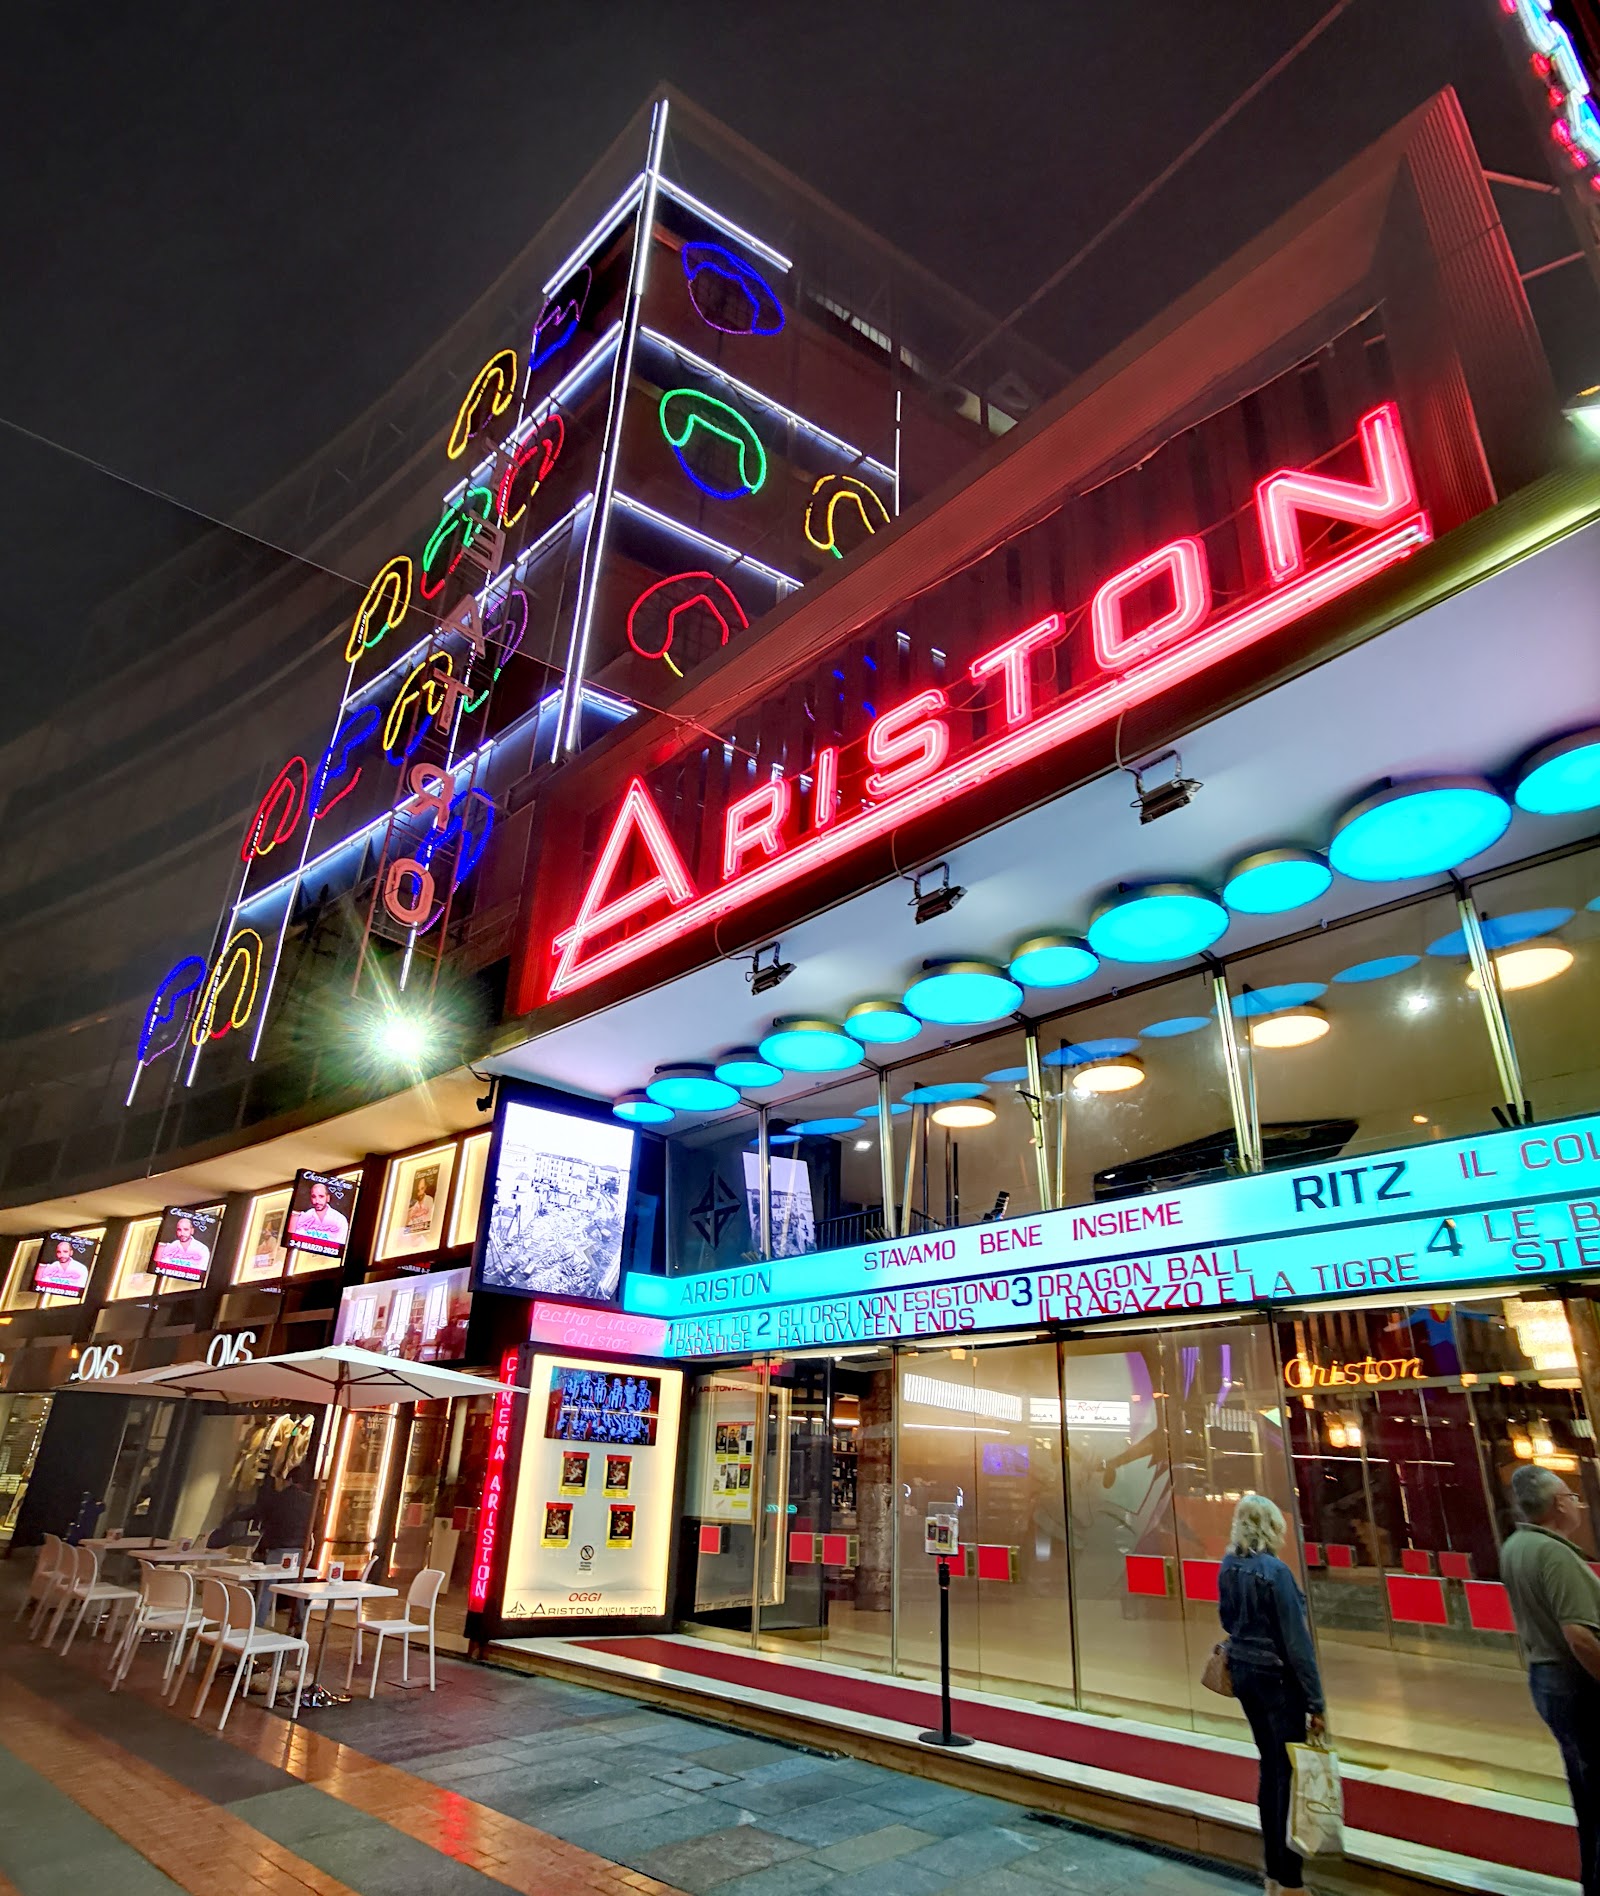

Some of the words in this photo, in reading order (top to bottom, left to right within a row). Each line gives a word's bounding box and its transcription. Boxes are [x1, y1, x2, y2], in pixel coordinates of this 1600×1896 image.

[550, 401, 1425, 1000] ARISTON
[1458, 1151, 1497, 1179] IL
[1292, 1160, 1412, 1212] RITZ
[301, 1241, 323, 1252] MARZO
[864, 1240, 955, 1270] STAVAMO
[979, 1224, 1042, 1254] BENE
[1073, 1201, 1183, 1240] INSIEME
[1427, 1219, 1463, 1256] 4
[1482, 1209, 1540, 1242] LE
[1511, 1235, 1600, 1271] STE
[680, 1269, 772, 1305] ARISTON
[1011, 1276, 1032, 1306] 3
[1038, 1261, 1151, 1297] DRAGON
[1167, 1249, 1252, 1282] BALL
[1038, 1298, 1059, 1322] IL
[1065, 1281, 1203, 1318] RAGAZZO
[1218, 1277, 1237, 1304] E
[1249, 1271, 1296, 1301] LA
[1311, 1253, 1420, 1291] TIGRE
[757, 1312, 771, 1337] 2
[779, 1307, 804, 1328] GLI
[810, 1302, 851, 1324] ORSI
[858, 1293, 897, 1319] NON
[903, 1279, 1010, 1312] ESISTONO
[675, 1331, 751, 1356] PARADISE
[676, 1319, 725, 1340] TICKET
[732, 1314, 750, 1332] TO
[777, 1314, 902, 1347] HALLOWEEN
[914, 1308, 976, 1332] ENDS
[78, 1344, 123, 1380] OVS
[207, 1331, 256, 1367] OVS
[494, 1357, 517, 1461] CINEMA
[475, 1475, 501, 1599] ARISTON
[530, 1602, 594, 1618] ARISTON
[568, 1592, 602, 1602] OGGI
